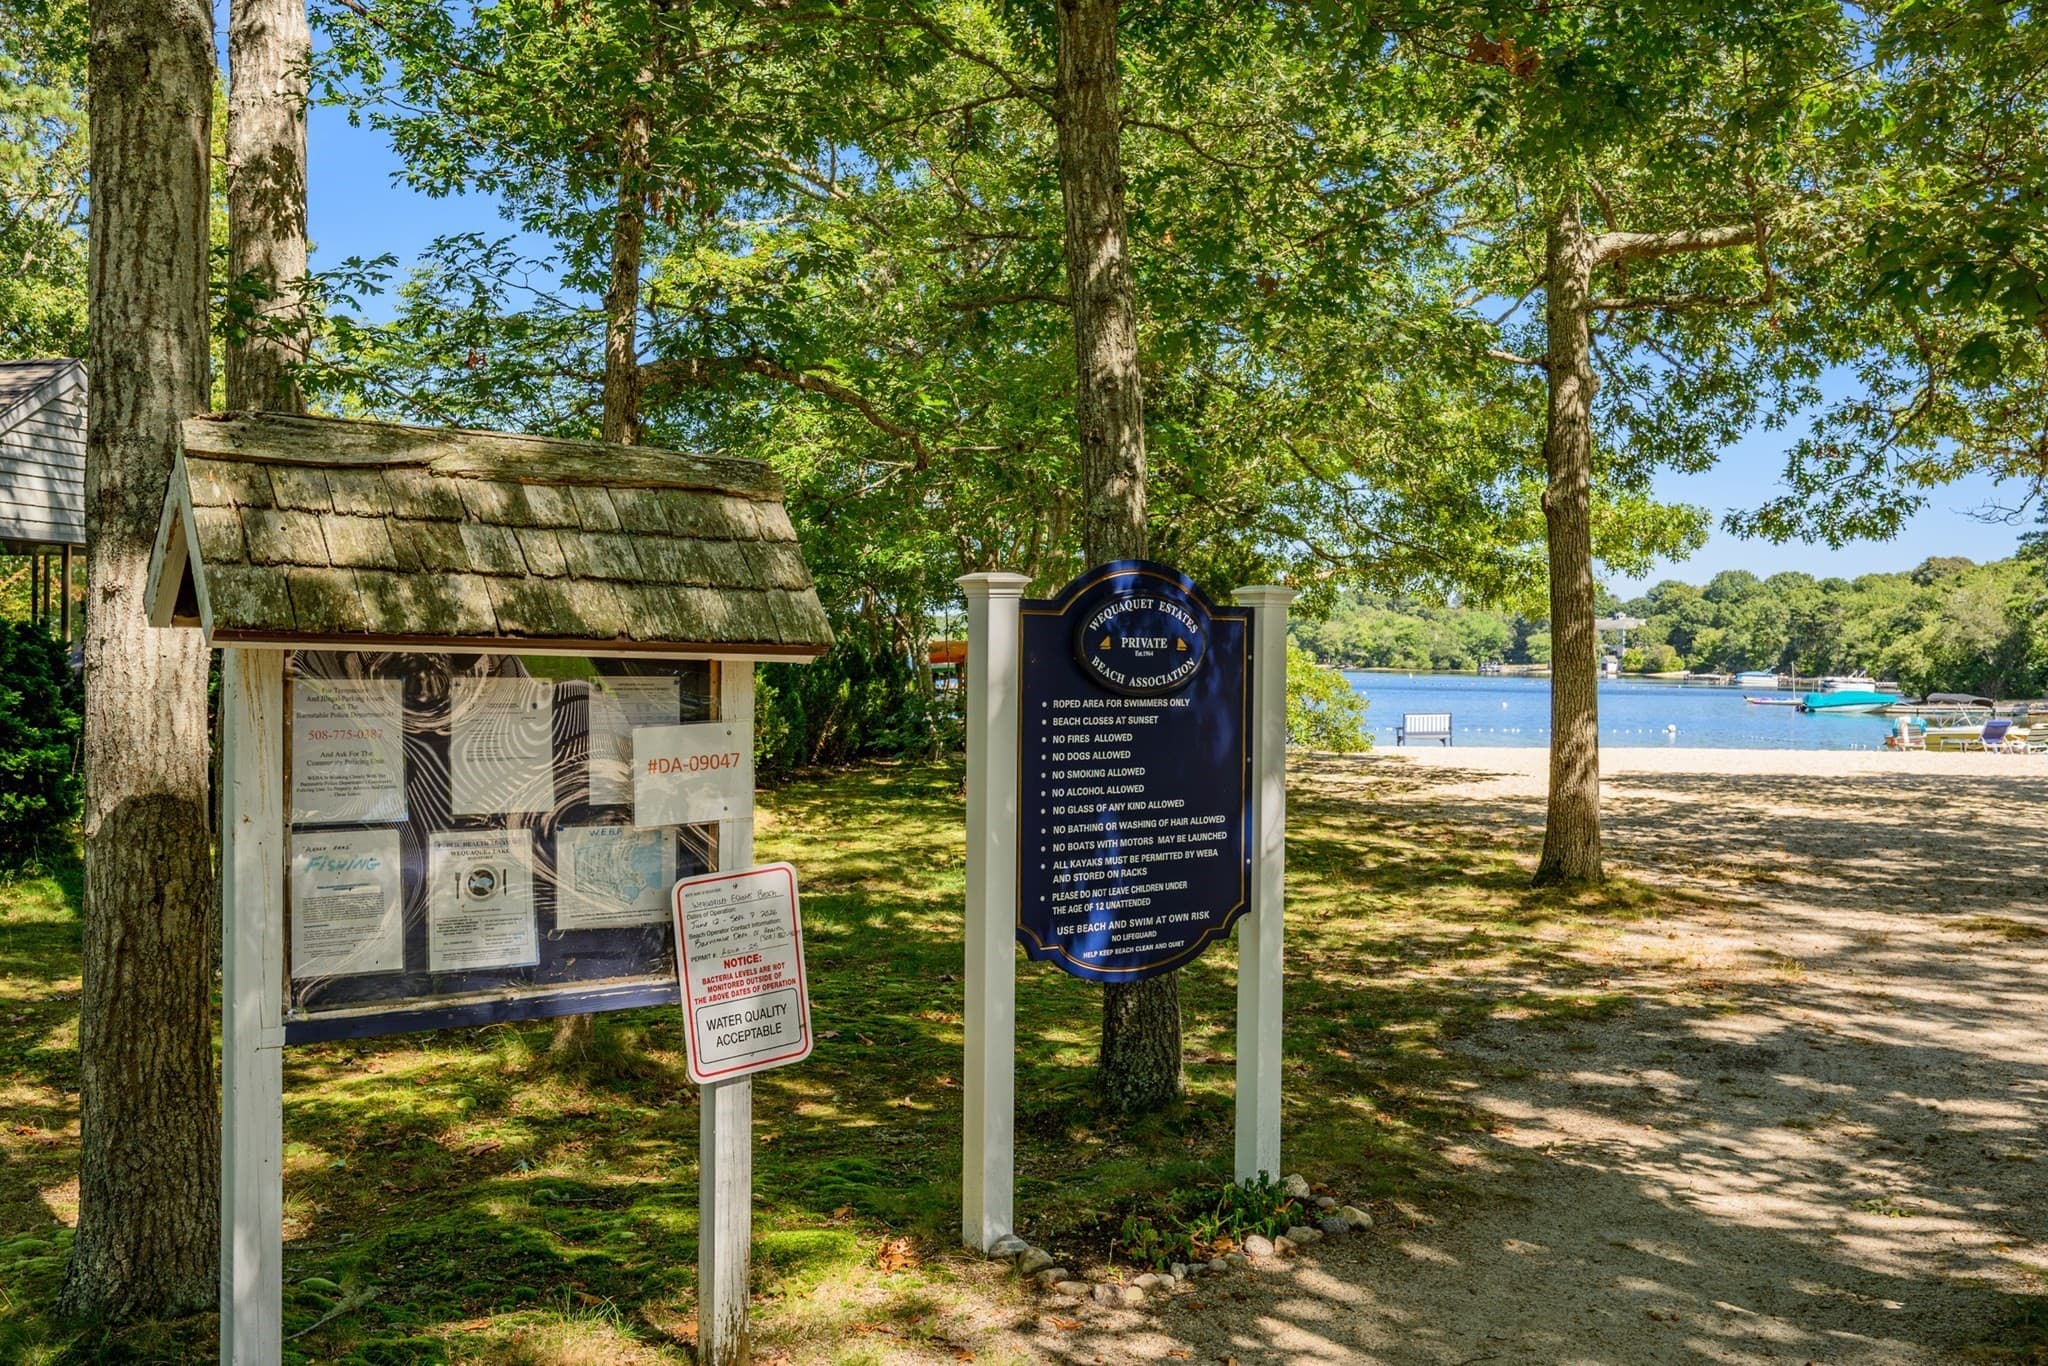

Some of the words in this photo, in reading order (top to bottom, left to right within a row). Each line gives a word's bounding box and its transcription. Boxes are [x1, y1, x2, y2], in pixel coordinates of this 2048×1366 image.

[1089, 599, 1154, 632] WEQUAQUET
[1159, 601, 1199, 634] ESTATES
[1121, 637, 1168, 649] PRIVATE
[1091, 655, 1124, 685] BEACH
[1129, 657, 1195, 688] ASSOCIATION
[1053, 700, 1081, 708] ROPED
[1082, 699, 1104, 708] AREA
[1106, 699, 1122, 708] FOR
[1124, 699, 1168, 707] SWIMMERS
[1169, 698, 1190, 707] ONLY
[1052, 717, 1081, 726] BEACH
[1082, 717, 1114, 725] CLOSES
[1115, 716, 1127, 725] AT
[1128, 716, 1159, 725] SUNSET
[1052, 735, 1065, 744] NO
[1067, 734, 1090, 743] FIRES
[1094, 733, 1133, 742] ALLOWED
[647, 752, 740, 775] #DA-09047
[1052, 753, 1065, 761] NO
[1067, 752, 1090, 761] DOGS
[1092, 751, 1131, 760] ALLOWED
[1052, 771, 1065, 780] NO
[1066, 769, 1106, 779] SMOKING
[1107, 768, 1145, 777] ALLOWED
[1052, 788, 1065, 797] NO
[1066, 787, 1105, 796] ALCOHOL
[1106, 785, 1144, 795] ALLOWED
[1052, 806, 1065, 815] NO
[1067, 805, 1094, 814] GLASS
[1096, 804, 1107, 813] OF
[1108, 803, 1126, 812] ANY
[1127, 802, 1146, 811] KIND
[1147, 800, 1185, 809] ALLOWED
[1053, 826, 1066, 835] NO
[1067, 824, 1104, 833] BATHING
[1105, 822, 1117, 832] OR
[1119, 819, 1157, 830] WASHING
[1158, 819, 1169, 828] OF
[1170, 817, 1188, 826] HAIR
[1190, 815, 1226, 825] ALLOWED
[1053, 843, 1066, 852] NO
[1067, 842, 1095, 851] BOATS
[1097, 840, 1117, 849] WITH
[1119, 837, 1154, 848] MOTORS
[1157, 836, 1175, 845] MAY
[1177, 835, 1187, 844] BE
[1187, 832, 1227, 842] LAUNCHED
[1053, 861, 1068, 870] ALL
[1070, 858, 1103, 869] KAYAKS
[1104, 856, 1128, 866] MUST
[1129, 855, 1140, 864] BE
[1141, 852, 1183, 863] PERMITTED
[1185, 851, 1195, 860] BY
[1196, 849, 1218, 858] WEBA
[1053, 874, 1071, 884] AND
[1073, 872, 1105, 882] STORED
[1107, 870, 1119, 879] ON
[1121, 868, 1148, 878] RACKS
[1052, 891, 1079, 902] PLEASE
[1080, 890, 1090, 899] DO
[1092, 888, 1107, 898] NOT
[1108, 886, 1130, 897] LEAVE
[1131, 883, 1164, 895] CHILDREN
[1165, 881, 1188, 891] UNDER
[1052, 906, 1067, 916] THE
[1068, 904, 1083, 914] AGE
[1084, 903, 1094, 912] OF
[1095, 901, 1104, 911] 12
[1106, 898, 1151, 910] UNATTENDED
[689, 931, 706, 940] Beach
[707, 927, 729, 937] Operator
[730, 923, 750, 932] Contact
[1056, 926, 1074, 936] USE
[1076, 922, 1106, 934] BEACH
[1108, 920, 1127, 931] AND
[1129, 917, 1154, 929] SWIM
[1155, 916, 1167, 925] AT
[1168, 913, 1190, 924] OWN
[1191, 911, 1210, 921] RISK
[1111, 934, 1121, 942] NO
[1122, 930, 1157, 941] LIFEGUARD
[1083, 951, 1098, 959] HELP
[1099, 949, 1113, 957] KEEP
[1115, 947, 1134, 956] BEACH
[1135, 945, 1154, 954] CLEAN
[1155, 943, 1167, 952] AND
[1168, 940, 1185, 950] QUIET
[724, 954, 762, 969] NOTICE:
[702, 974, 733, 985] BACTERIA
[735, 969, 757, 979] LEVELS
[759, 966, 771, 974] ARE
[773, 962, 785, 970] NOT
[708, 979, 745, 993] MONITORED
[747, 974, 772, 985] OUTSIDE
[774, 972, 782, 980] OF
[695, 996, 707, 1005] THE
[709, 991, 730, 1002] ABOVE
[732, 988, 751, 998] DATES
[753, 985, 760, 993] OF
[762, 978, 796, 991] OPERATION
[706, 1013, 742, 1031] WATER
[745, 1003, 787, 1022] QUALITY
[716, 1023, 782, 1047] ACCEPTABLE
